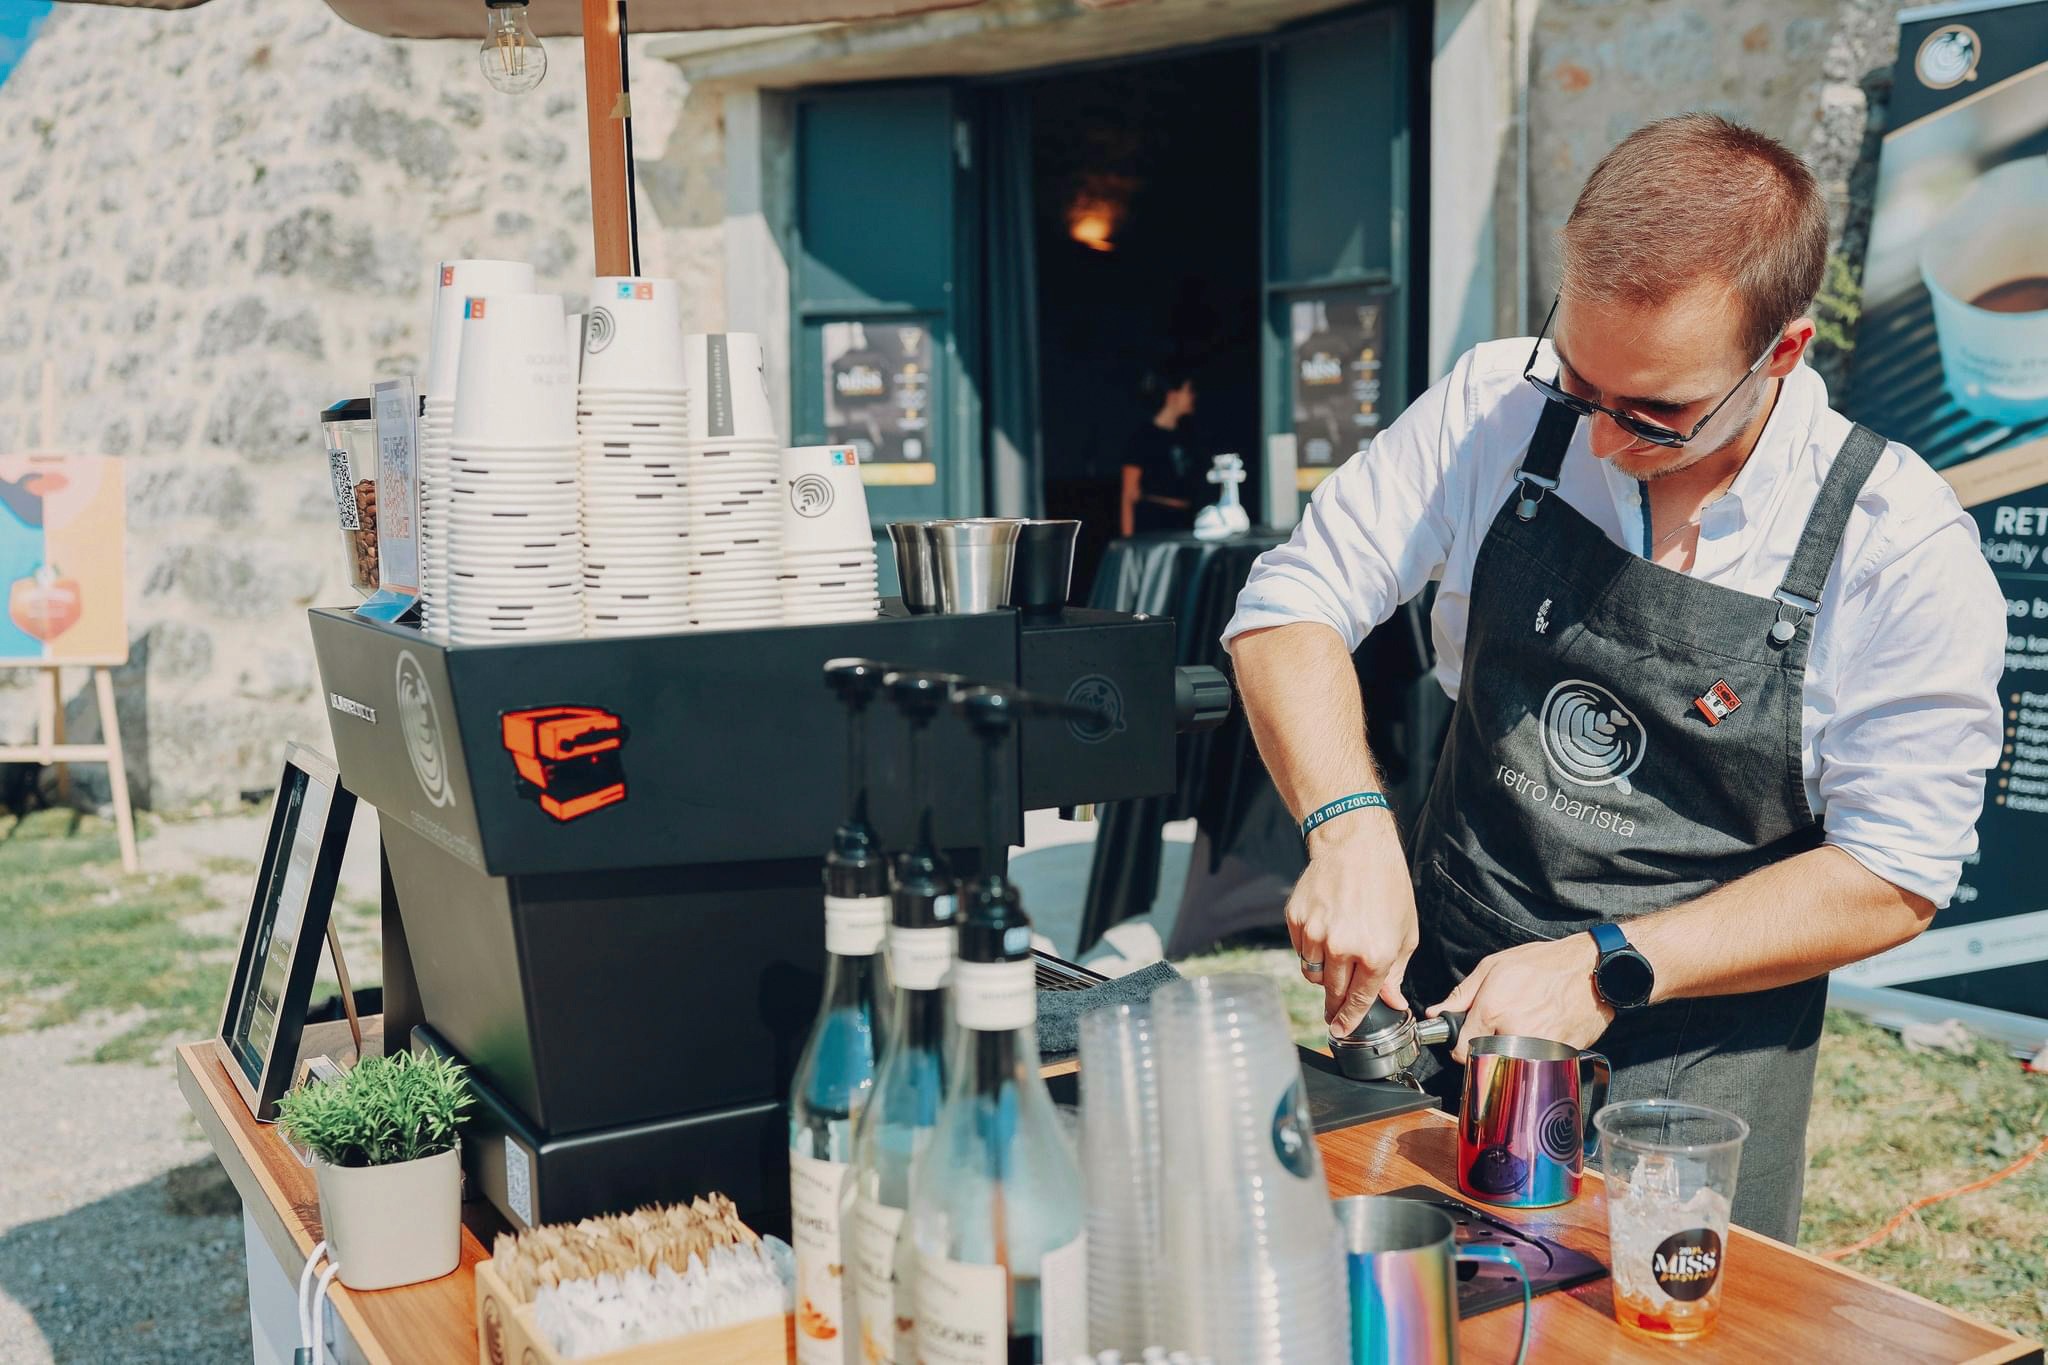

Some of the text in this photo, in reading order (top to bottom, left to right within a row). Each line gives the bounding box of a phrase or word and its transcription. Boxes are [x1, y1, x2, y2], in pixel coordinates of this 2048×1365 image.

[1994, 505, 2048, 536] RET
[1313, 795, 1380, 824] la marzocco
[1496, 763, 1636, 838] retro barista
